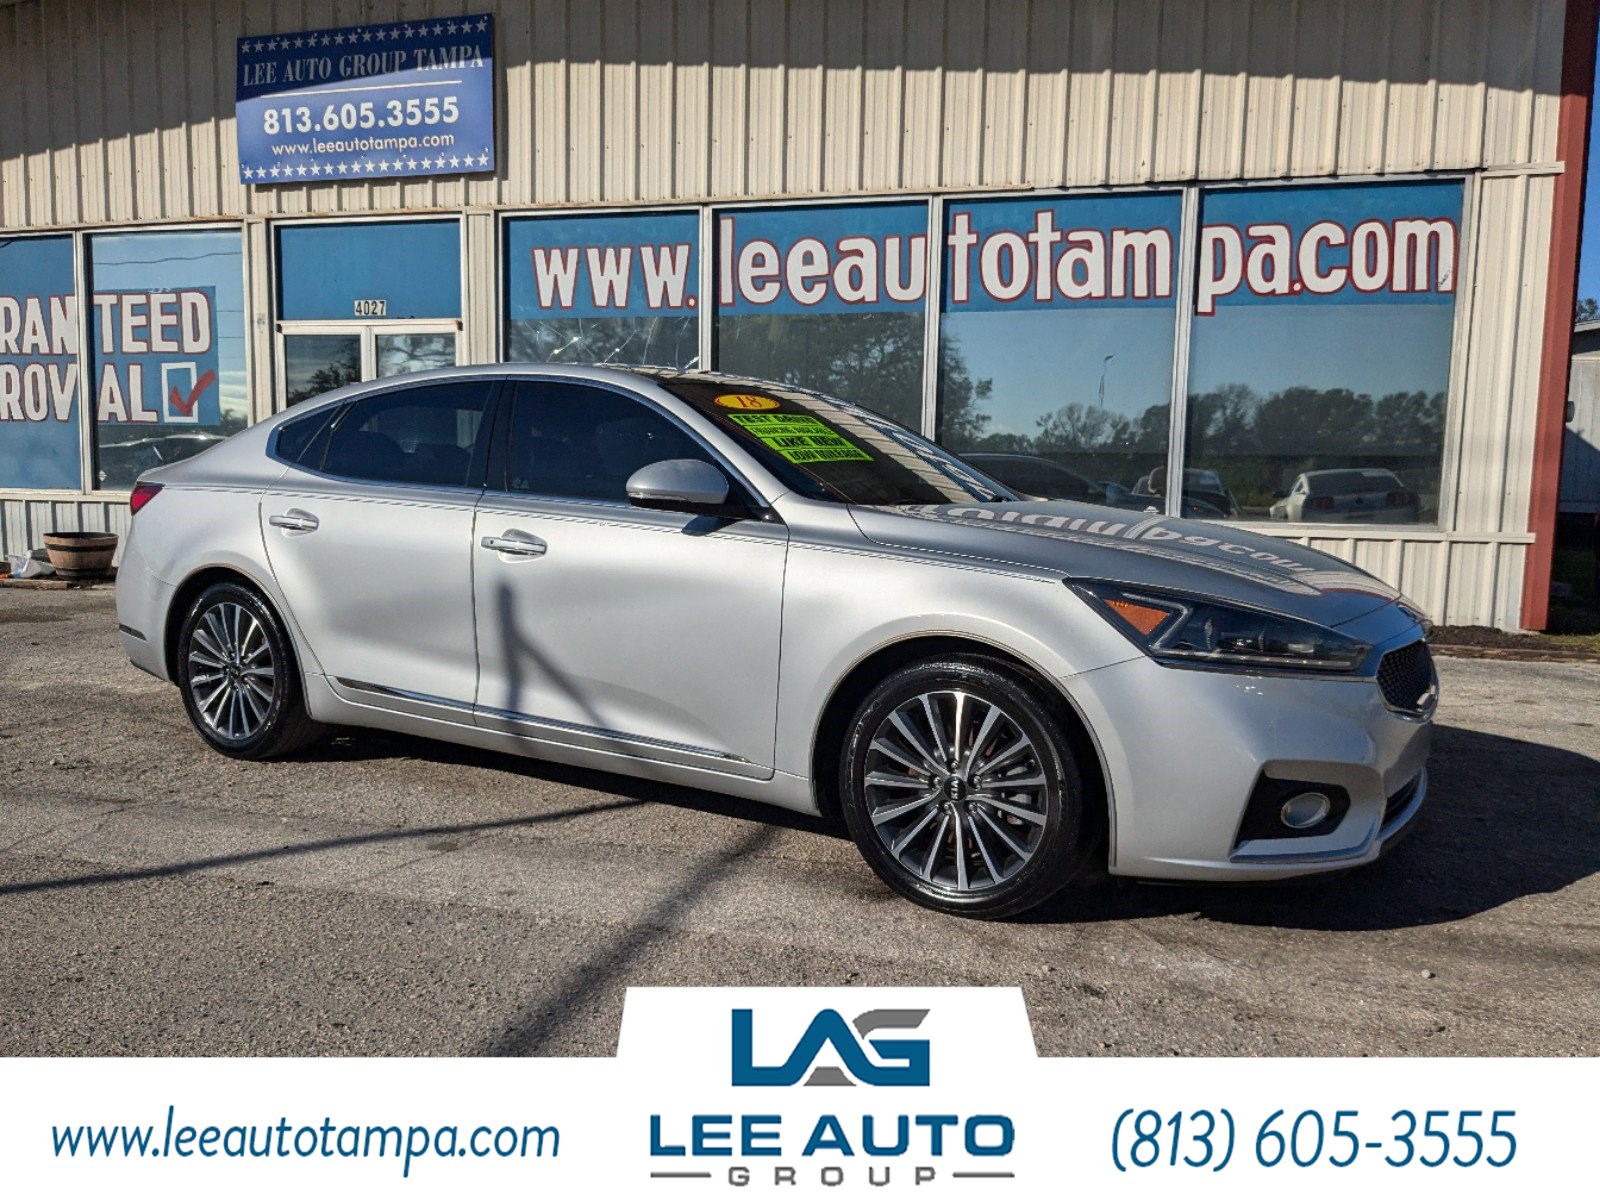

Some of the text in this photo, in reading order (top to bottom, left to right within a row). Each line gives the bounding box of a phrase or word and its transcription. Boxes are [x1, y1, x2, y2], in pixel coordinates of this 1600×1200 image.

[243, 45, 484, 87] LEE AUTO GROUP TAMPA
[263, 96, 459, 135] 813.605.3555
[271, 133, 455, 156] www.leeautotampa.com
[355, 300, 386, 315] 4027
[950, 779, 959, 800] KIA
